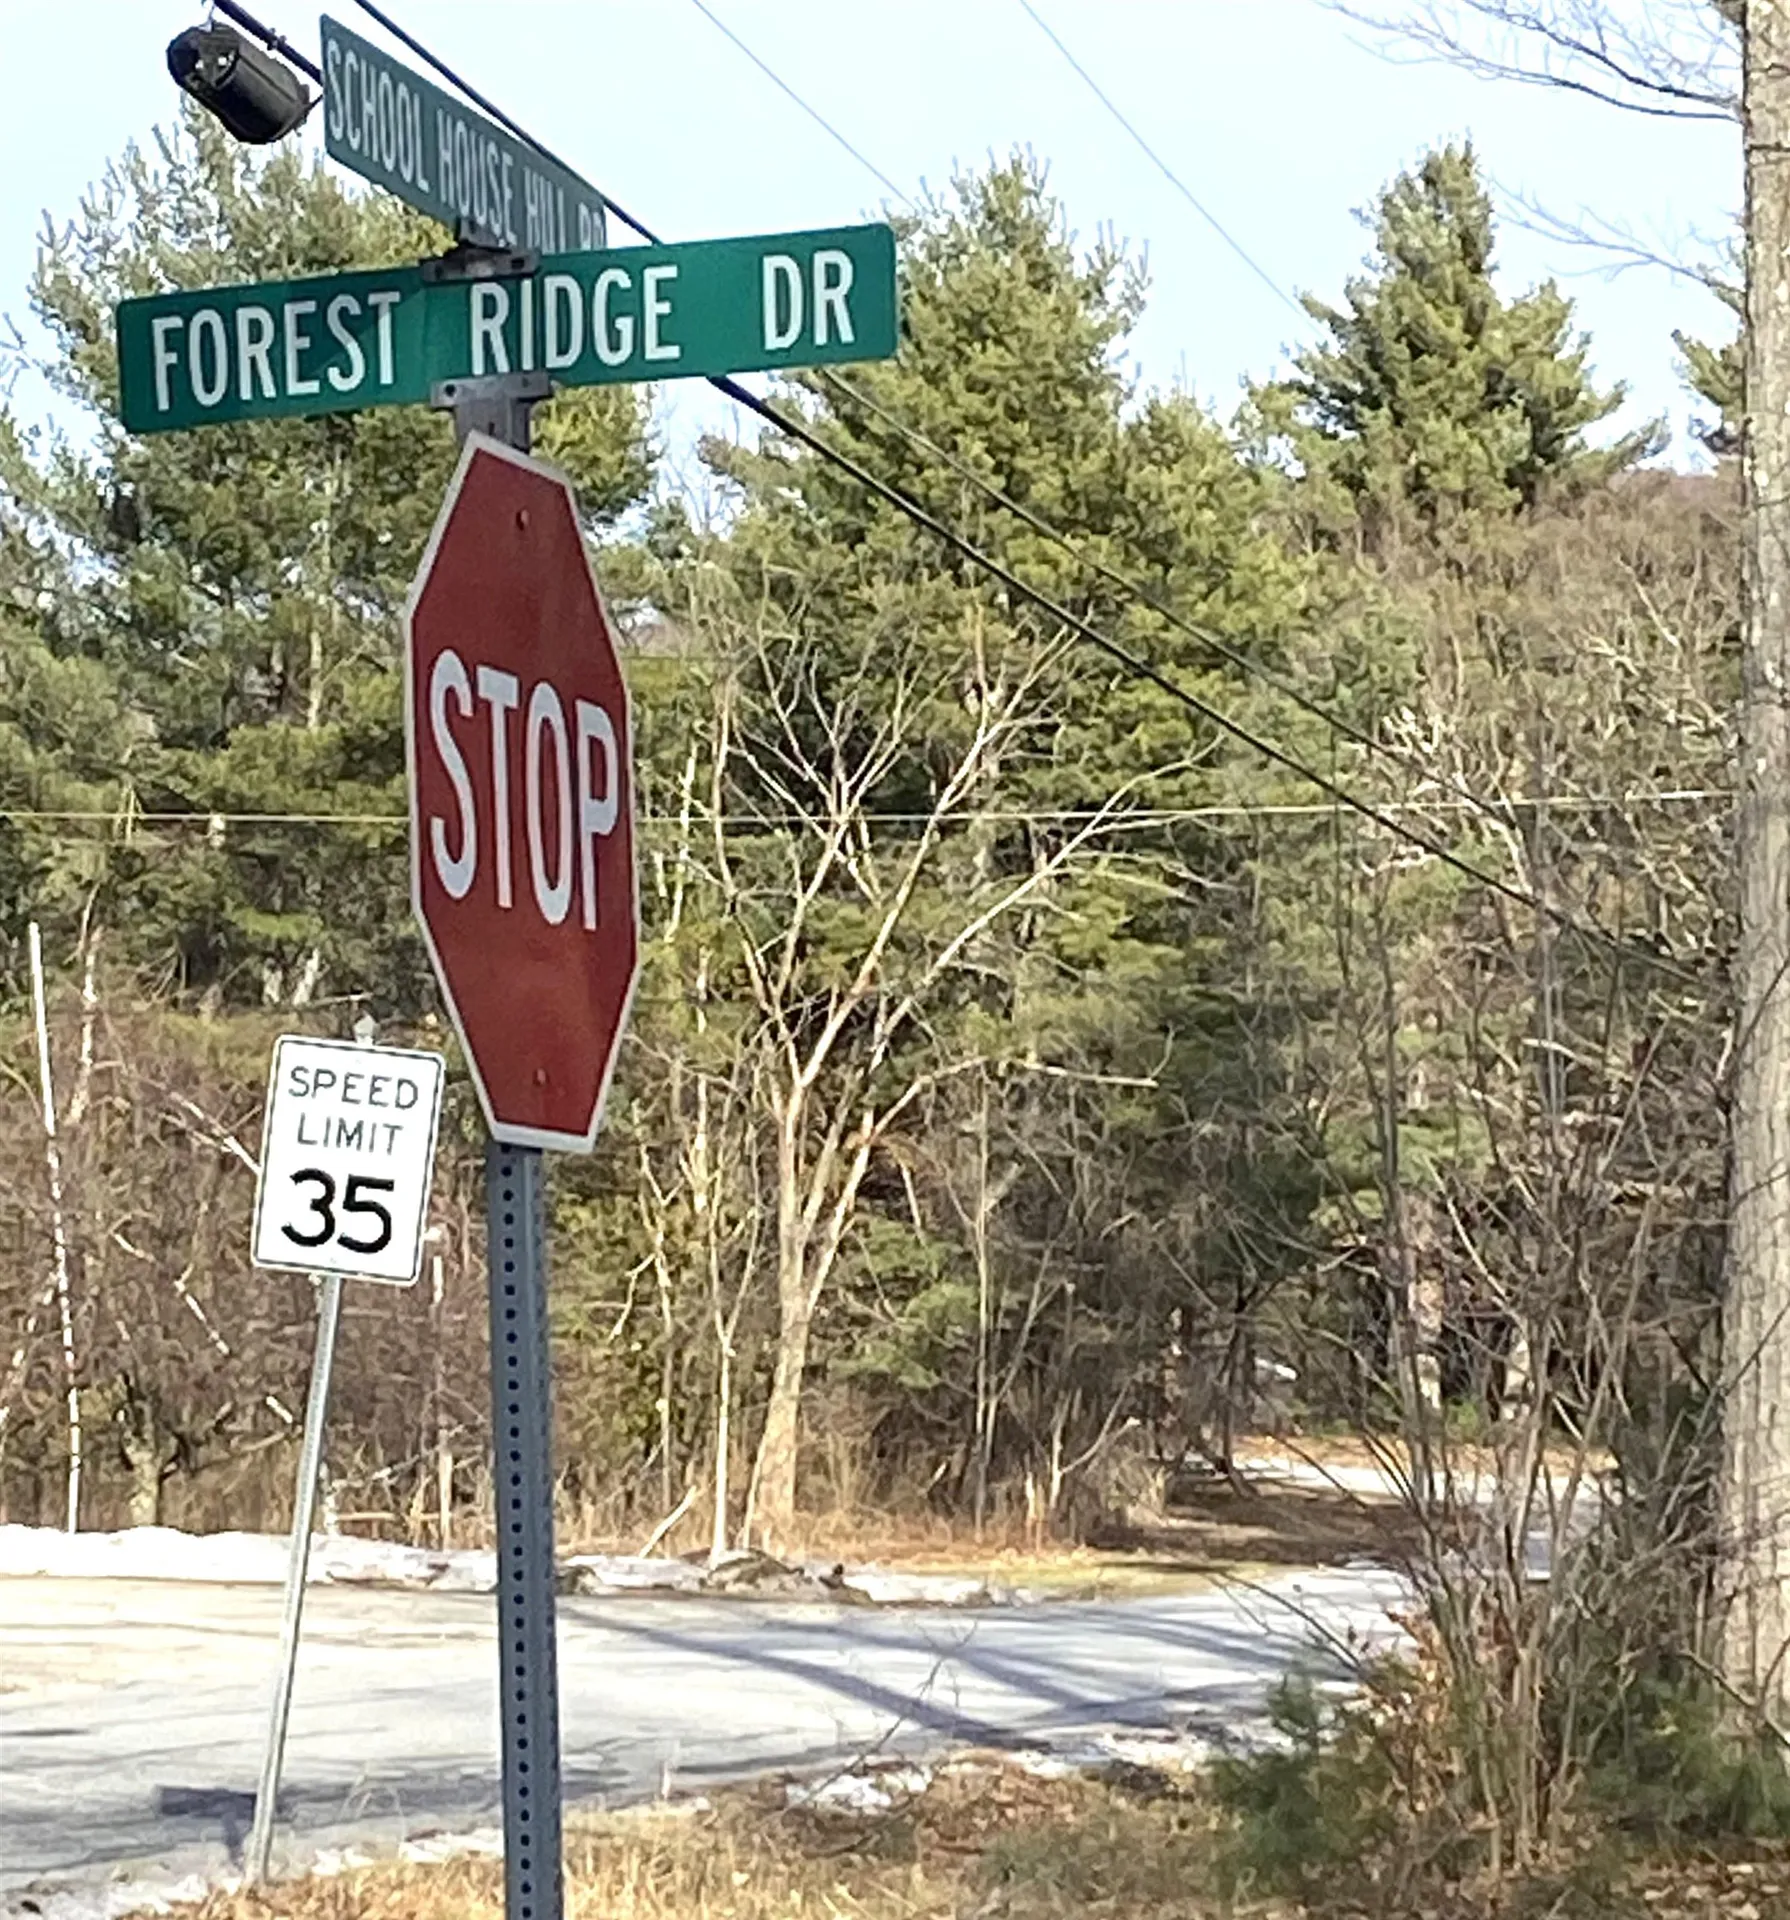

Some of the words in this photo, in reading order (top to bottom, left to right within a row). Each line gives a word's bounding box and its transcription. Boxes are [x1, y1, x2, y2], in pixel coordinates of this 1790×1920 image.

[326, 37, 431, 194] SCHOOL
[436, 108, 518, 248] HOUSE
[524, 166, 567, 255] HILL
[151, 290, 401, 412] FOREST
[470, 264, 681, 377] RIDGE
[761, 249, 856, 352] DR
[429, 648, 619, 932] STOP
[288, 1065, 419, 1110] SPEED
[296, 1112, 403, 1156] LIMIT
[281, 1167, 395, 1255] 35
